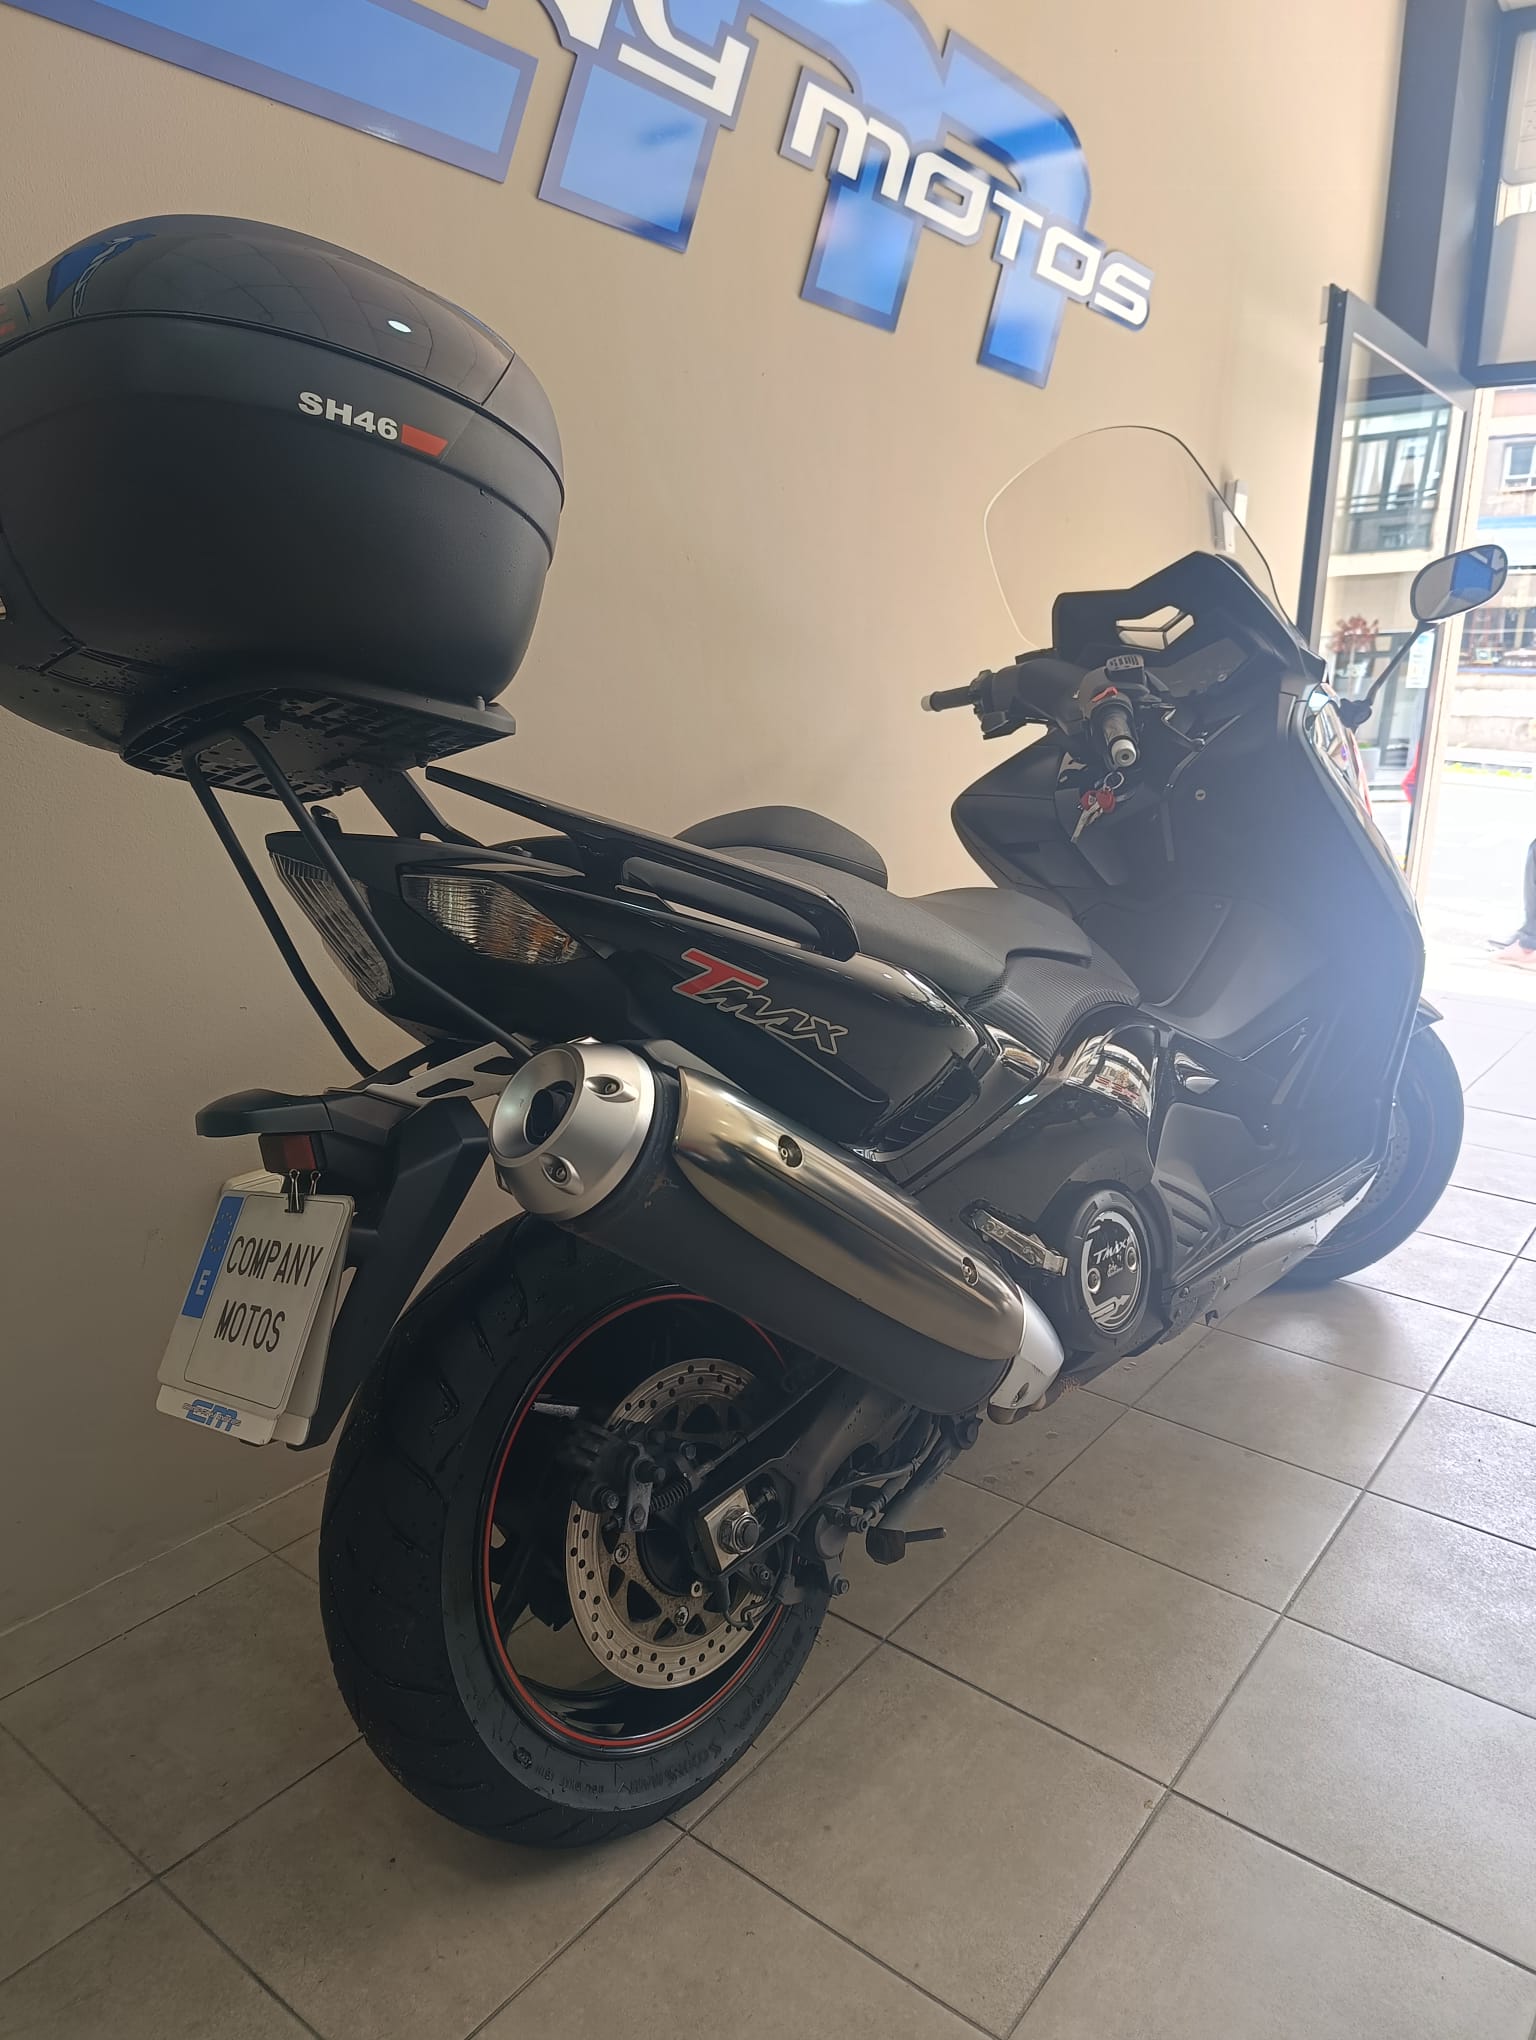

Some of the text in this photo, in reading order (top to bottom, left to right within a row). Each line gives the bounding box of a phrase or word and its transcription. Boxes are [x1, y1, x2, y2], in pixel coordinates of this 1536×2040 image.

[298, 391, 399, 440] SH46
[195, 1270, 211, 1296] E
[226, 1236, 324, 1287] COMPANY
[213, 1299, 286, 1353] MOTOS
